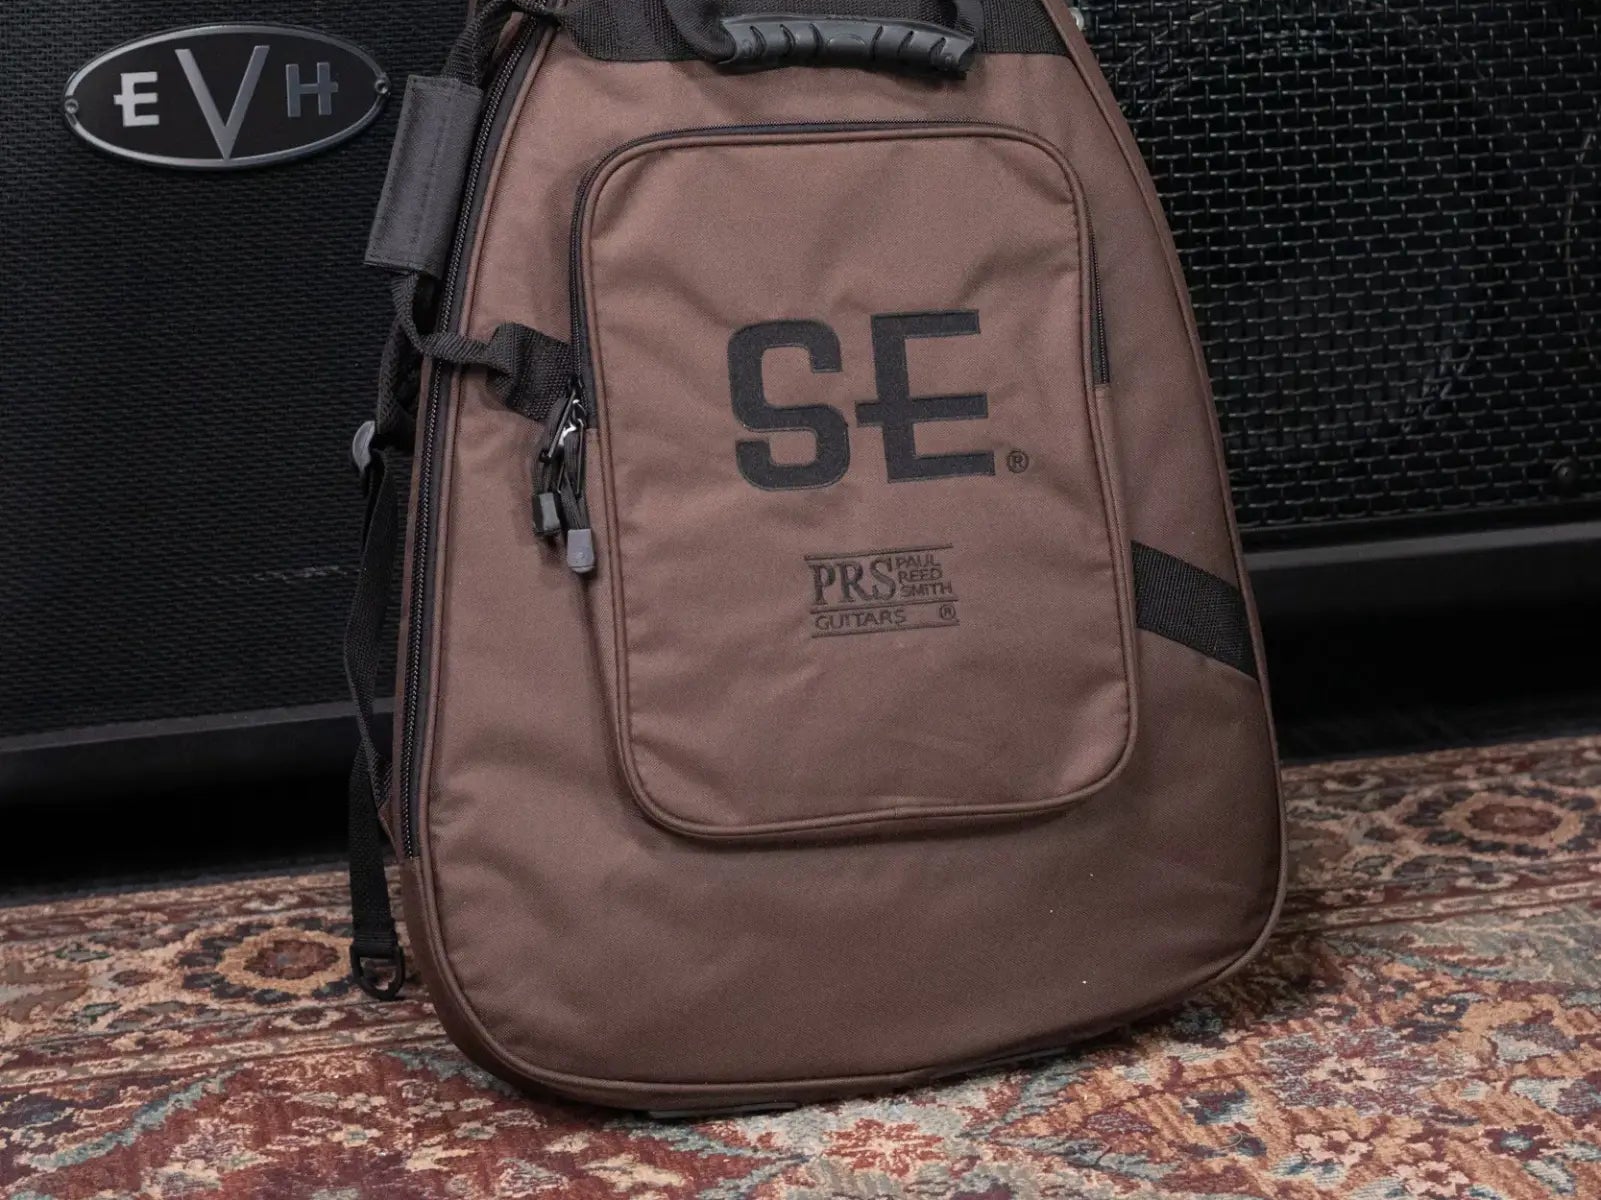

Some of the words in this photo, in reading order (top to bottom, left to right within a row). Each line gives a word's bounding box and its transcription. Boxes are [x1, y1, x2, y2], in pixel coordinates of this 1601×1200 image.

[113, 45, 339, 160] EVH
[727, 308, 996, 491] SE
[895, 553, 942, 569] PAUL
[808, 557, 897, 606] PRS
[897, 567, 943, 583] REED
[899, 581, 953, 598] SMITH
[815, 609, 907, 631] GUITARS
